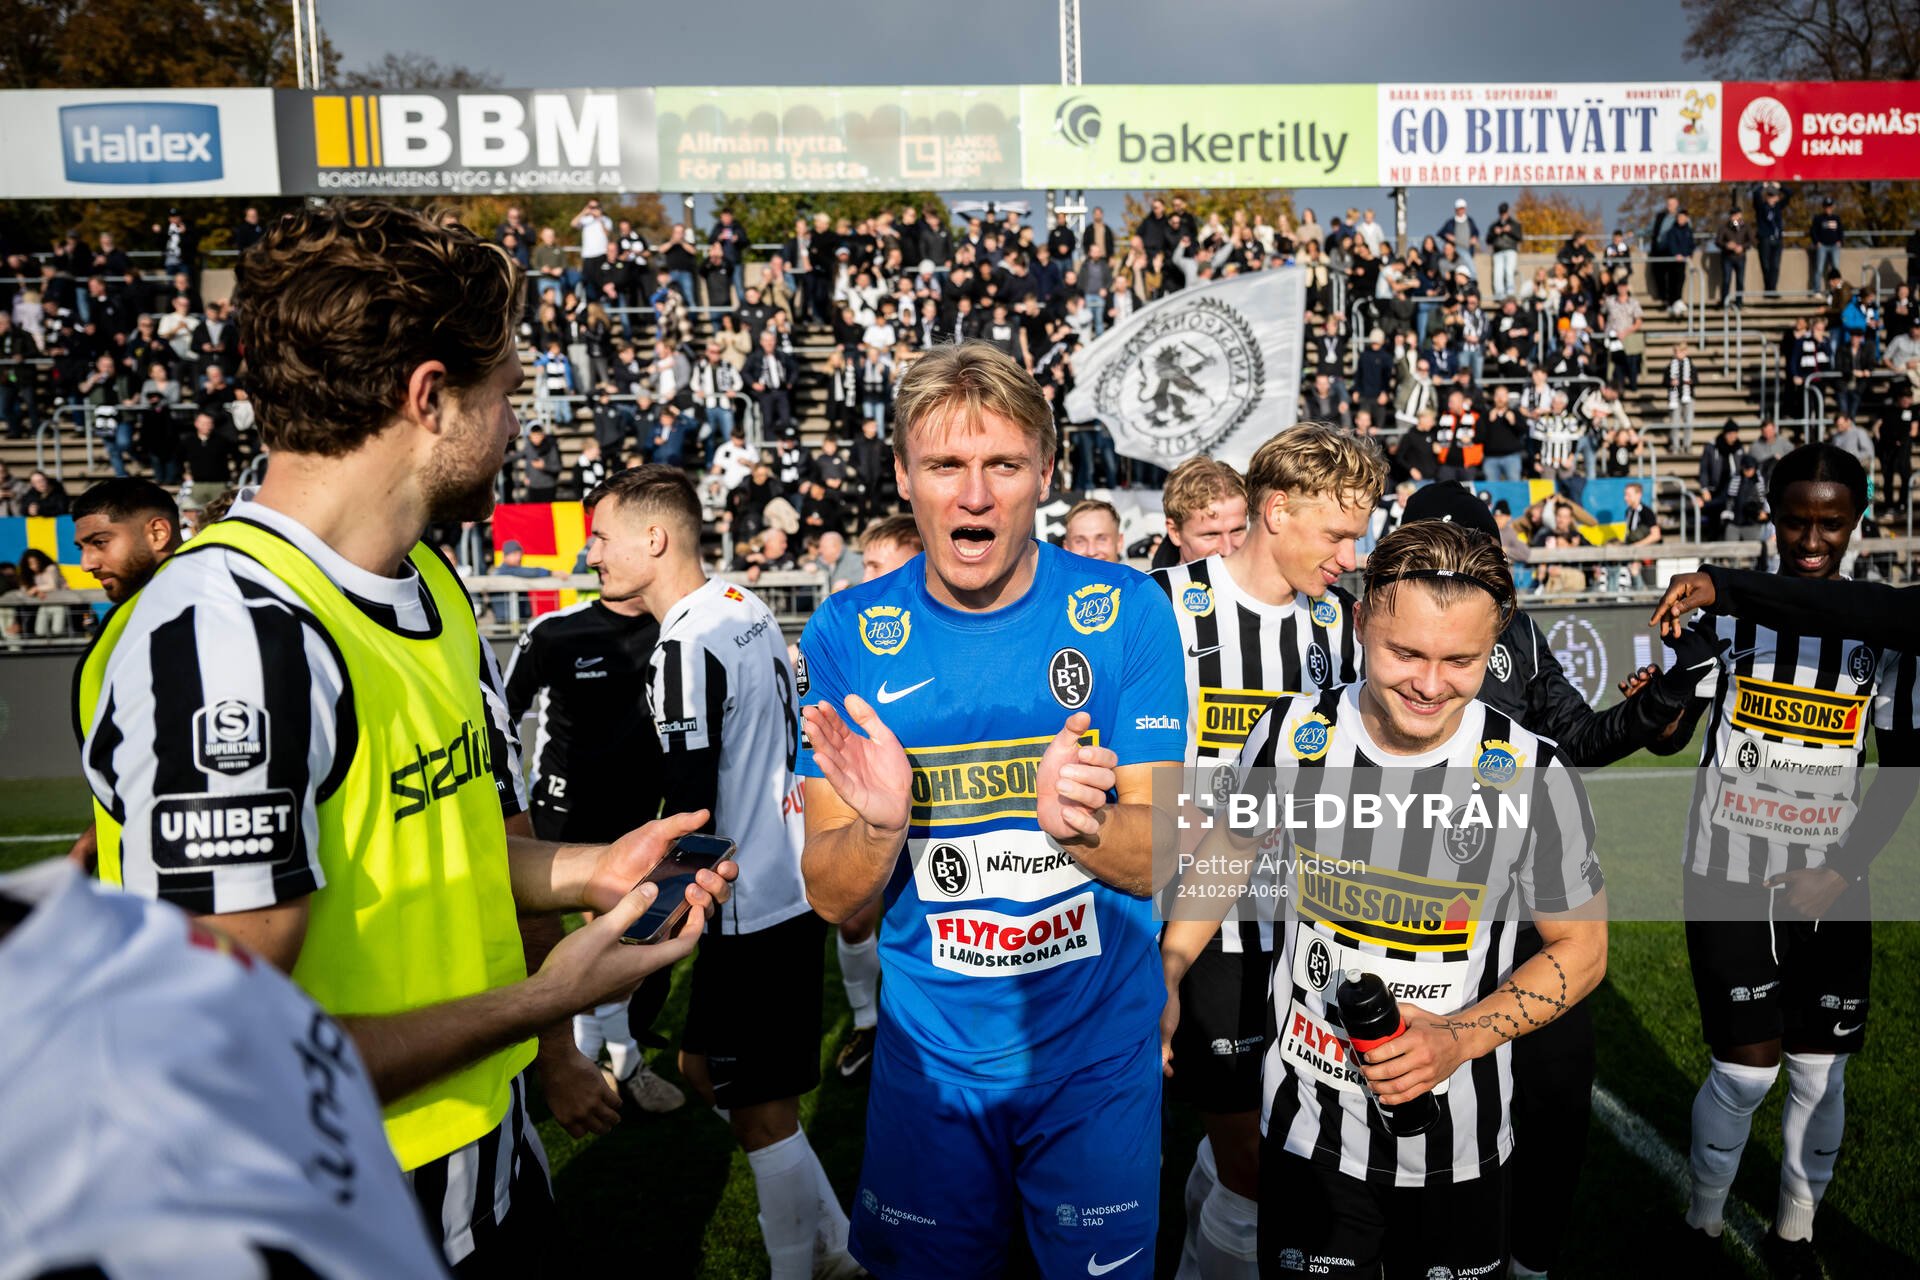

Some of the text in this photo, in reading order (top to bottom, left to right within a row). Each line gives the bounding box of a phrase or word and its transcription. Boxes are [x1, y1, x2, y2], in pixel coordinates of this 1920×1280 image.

[380, 95, 620, 167] BBM
[1392, 99, 1658, 154] GO BILTVÄTT
[72, 125, 213, 164] Haldex
[678, 131, 847, 158] Allmän nytta.
[1118, 122, 1348, 174] bakertilly
[1802, 135, 1863, 156] I SKÅNE
[317, 170, 621, 188] BORSTAHUSENS BYGG & MONTAGE AB
[679, 157, 721, 179] För
[727, 158, 785, 179] allas
[1390, 166, 1411, 182] NU
[1419, 163, 1461, 181] BÅDE
[1468, 162, 1487, 181] PÅ
[1594, 166, 1604, 180] &
[1611, 163, 1718, 180] PUMPGATAN!
[1206, 706, 1260, 731] OHLS
[1741, 691, 1845, 729] OHLSSONS
[660, 720, 697, 733] stadium
[1136, 715, 1180, 731] stadium
[391, 720, 492, 823] stadiu
[1770, 758, 1843, 776] NÄTVERKET
[549, 775, 567, 798] 12
[912, 761, 1041, 804] OHLSSON
[1723, 791, 1842, 824] FLYTGOLV
[160, 805, 291, 842] UNIBET
[1729, 810, 1820, 836] LANDSKRONA
[1824, 826, 1839, 836] AB
[987, 851, 1076, 874] NÄTVERK
[1304, 872, 1444, 931] OHLSSONS
[936, 904, 1086, 951] FLYTGOLV
[950, 945, 1060, 967] LANDSKRONA
[1064, 935, 1088, 952] AB
[1292, 1012, 1356, 1065] FLYT
[880, 1213, 899, 1226] STAD
[881, 1204, 937, 1227] LANDSKRONA
[1081, 1200, 1139, 1216] LANDSKRONA
[1082, 1217, 1104, 1227] STAD
[1309, 1255, 1355, 1267] LANDSKRONA
[1309, 1265, 1329, 1274] STAD
[1457, 1259, 1501, 1276] LANDSKRONA
